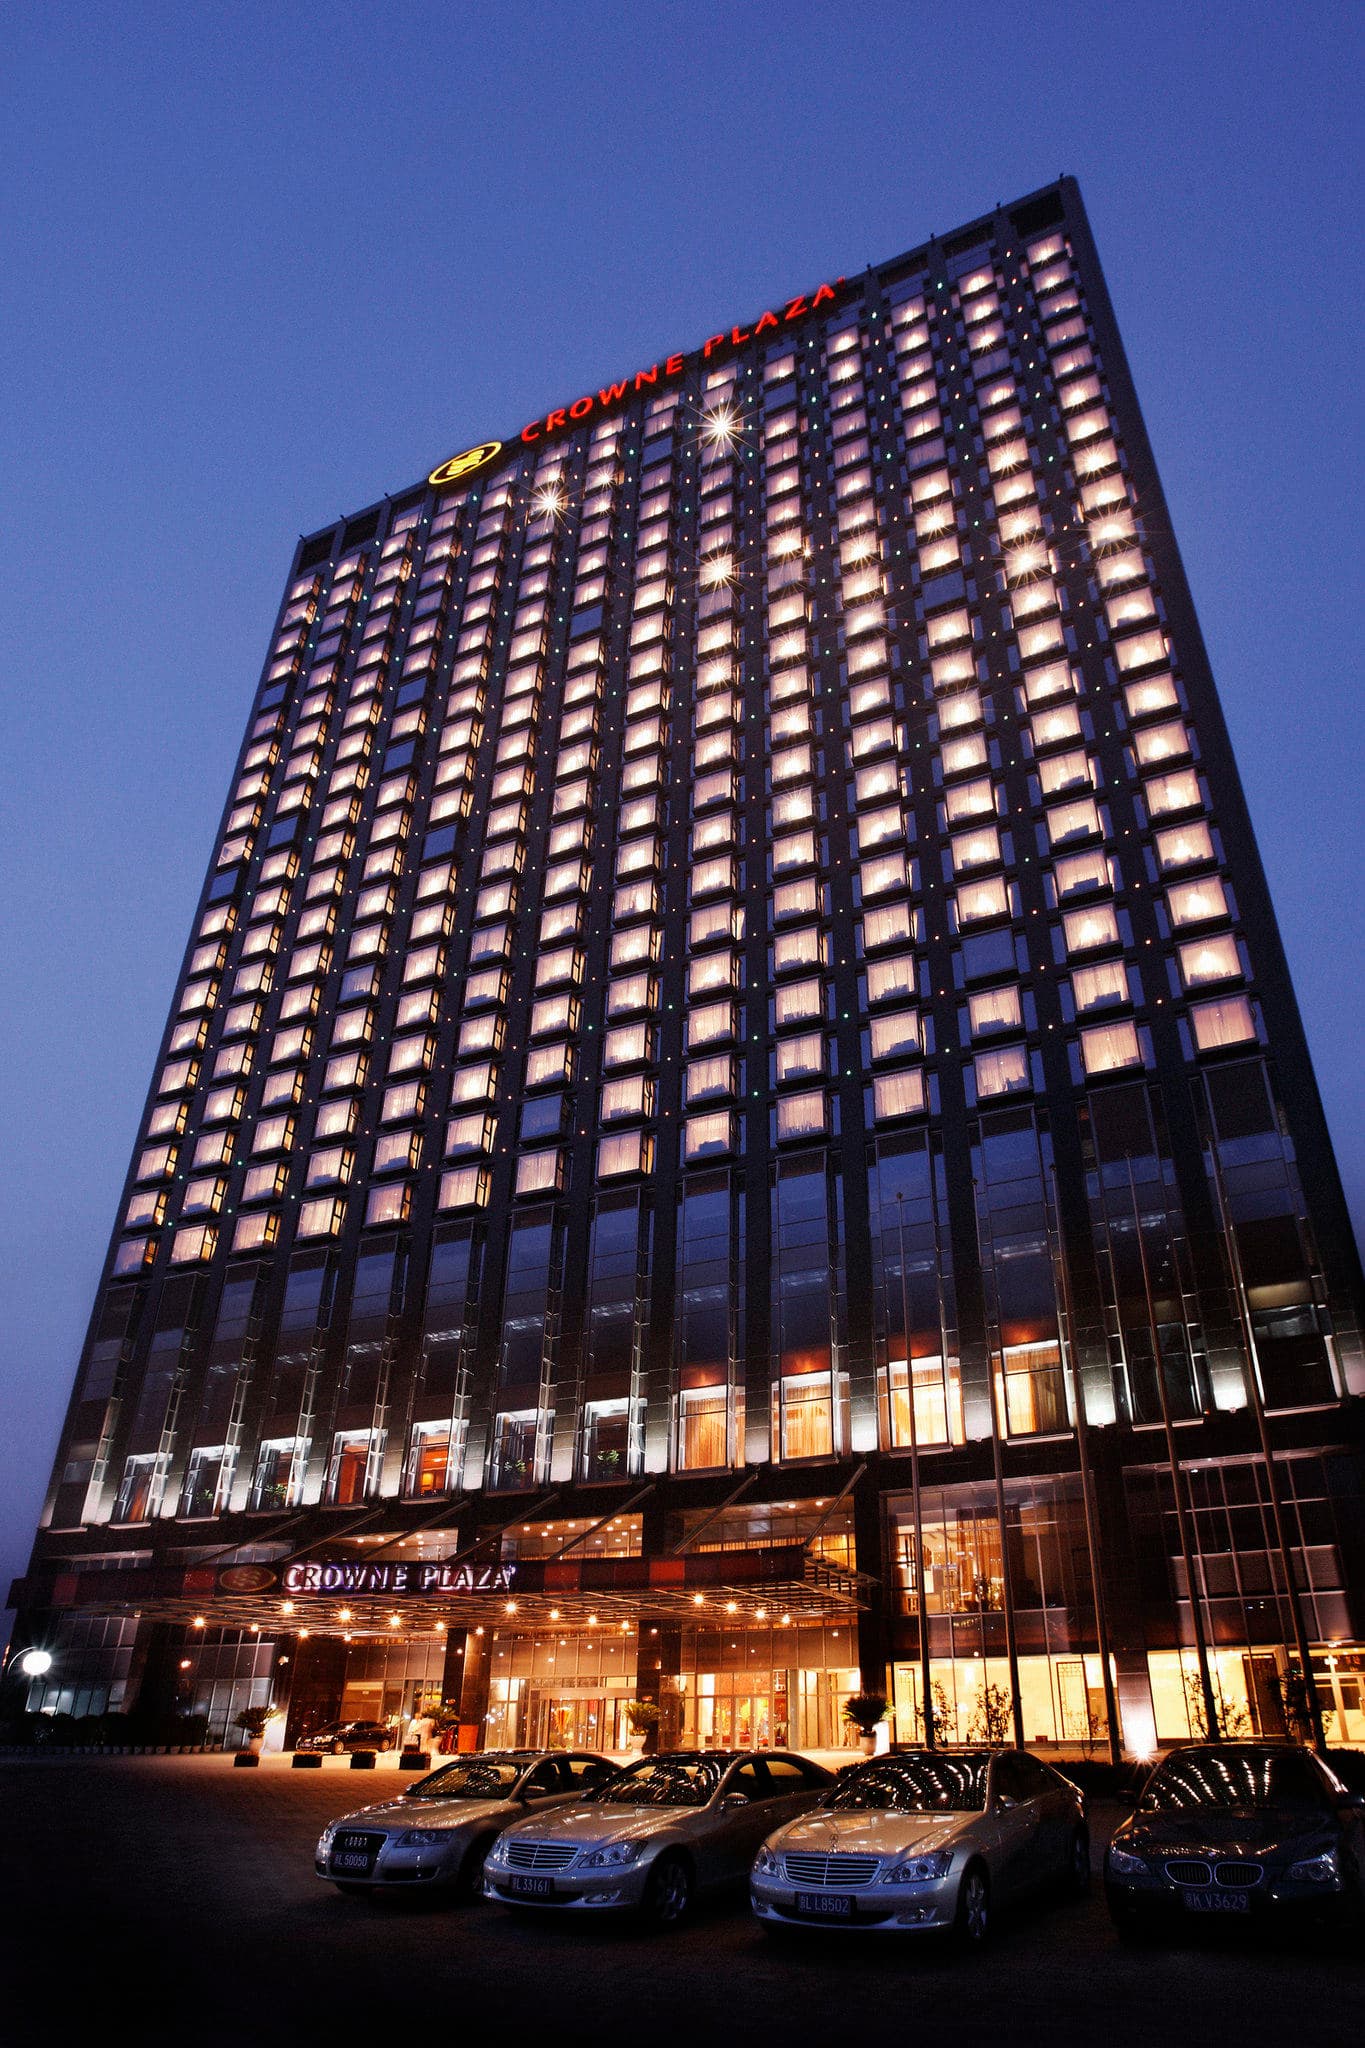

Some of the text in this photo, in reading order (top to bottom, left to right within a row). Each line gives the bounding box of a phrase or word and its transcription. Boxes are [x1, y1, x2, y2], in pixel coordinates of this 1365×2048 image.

[521, 284, 835, 443] CROWNE PLAZA
[284, 1564, 512, 1592] CROWNE PLAZA
